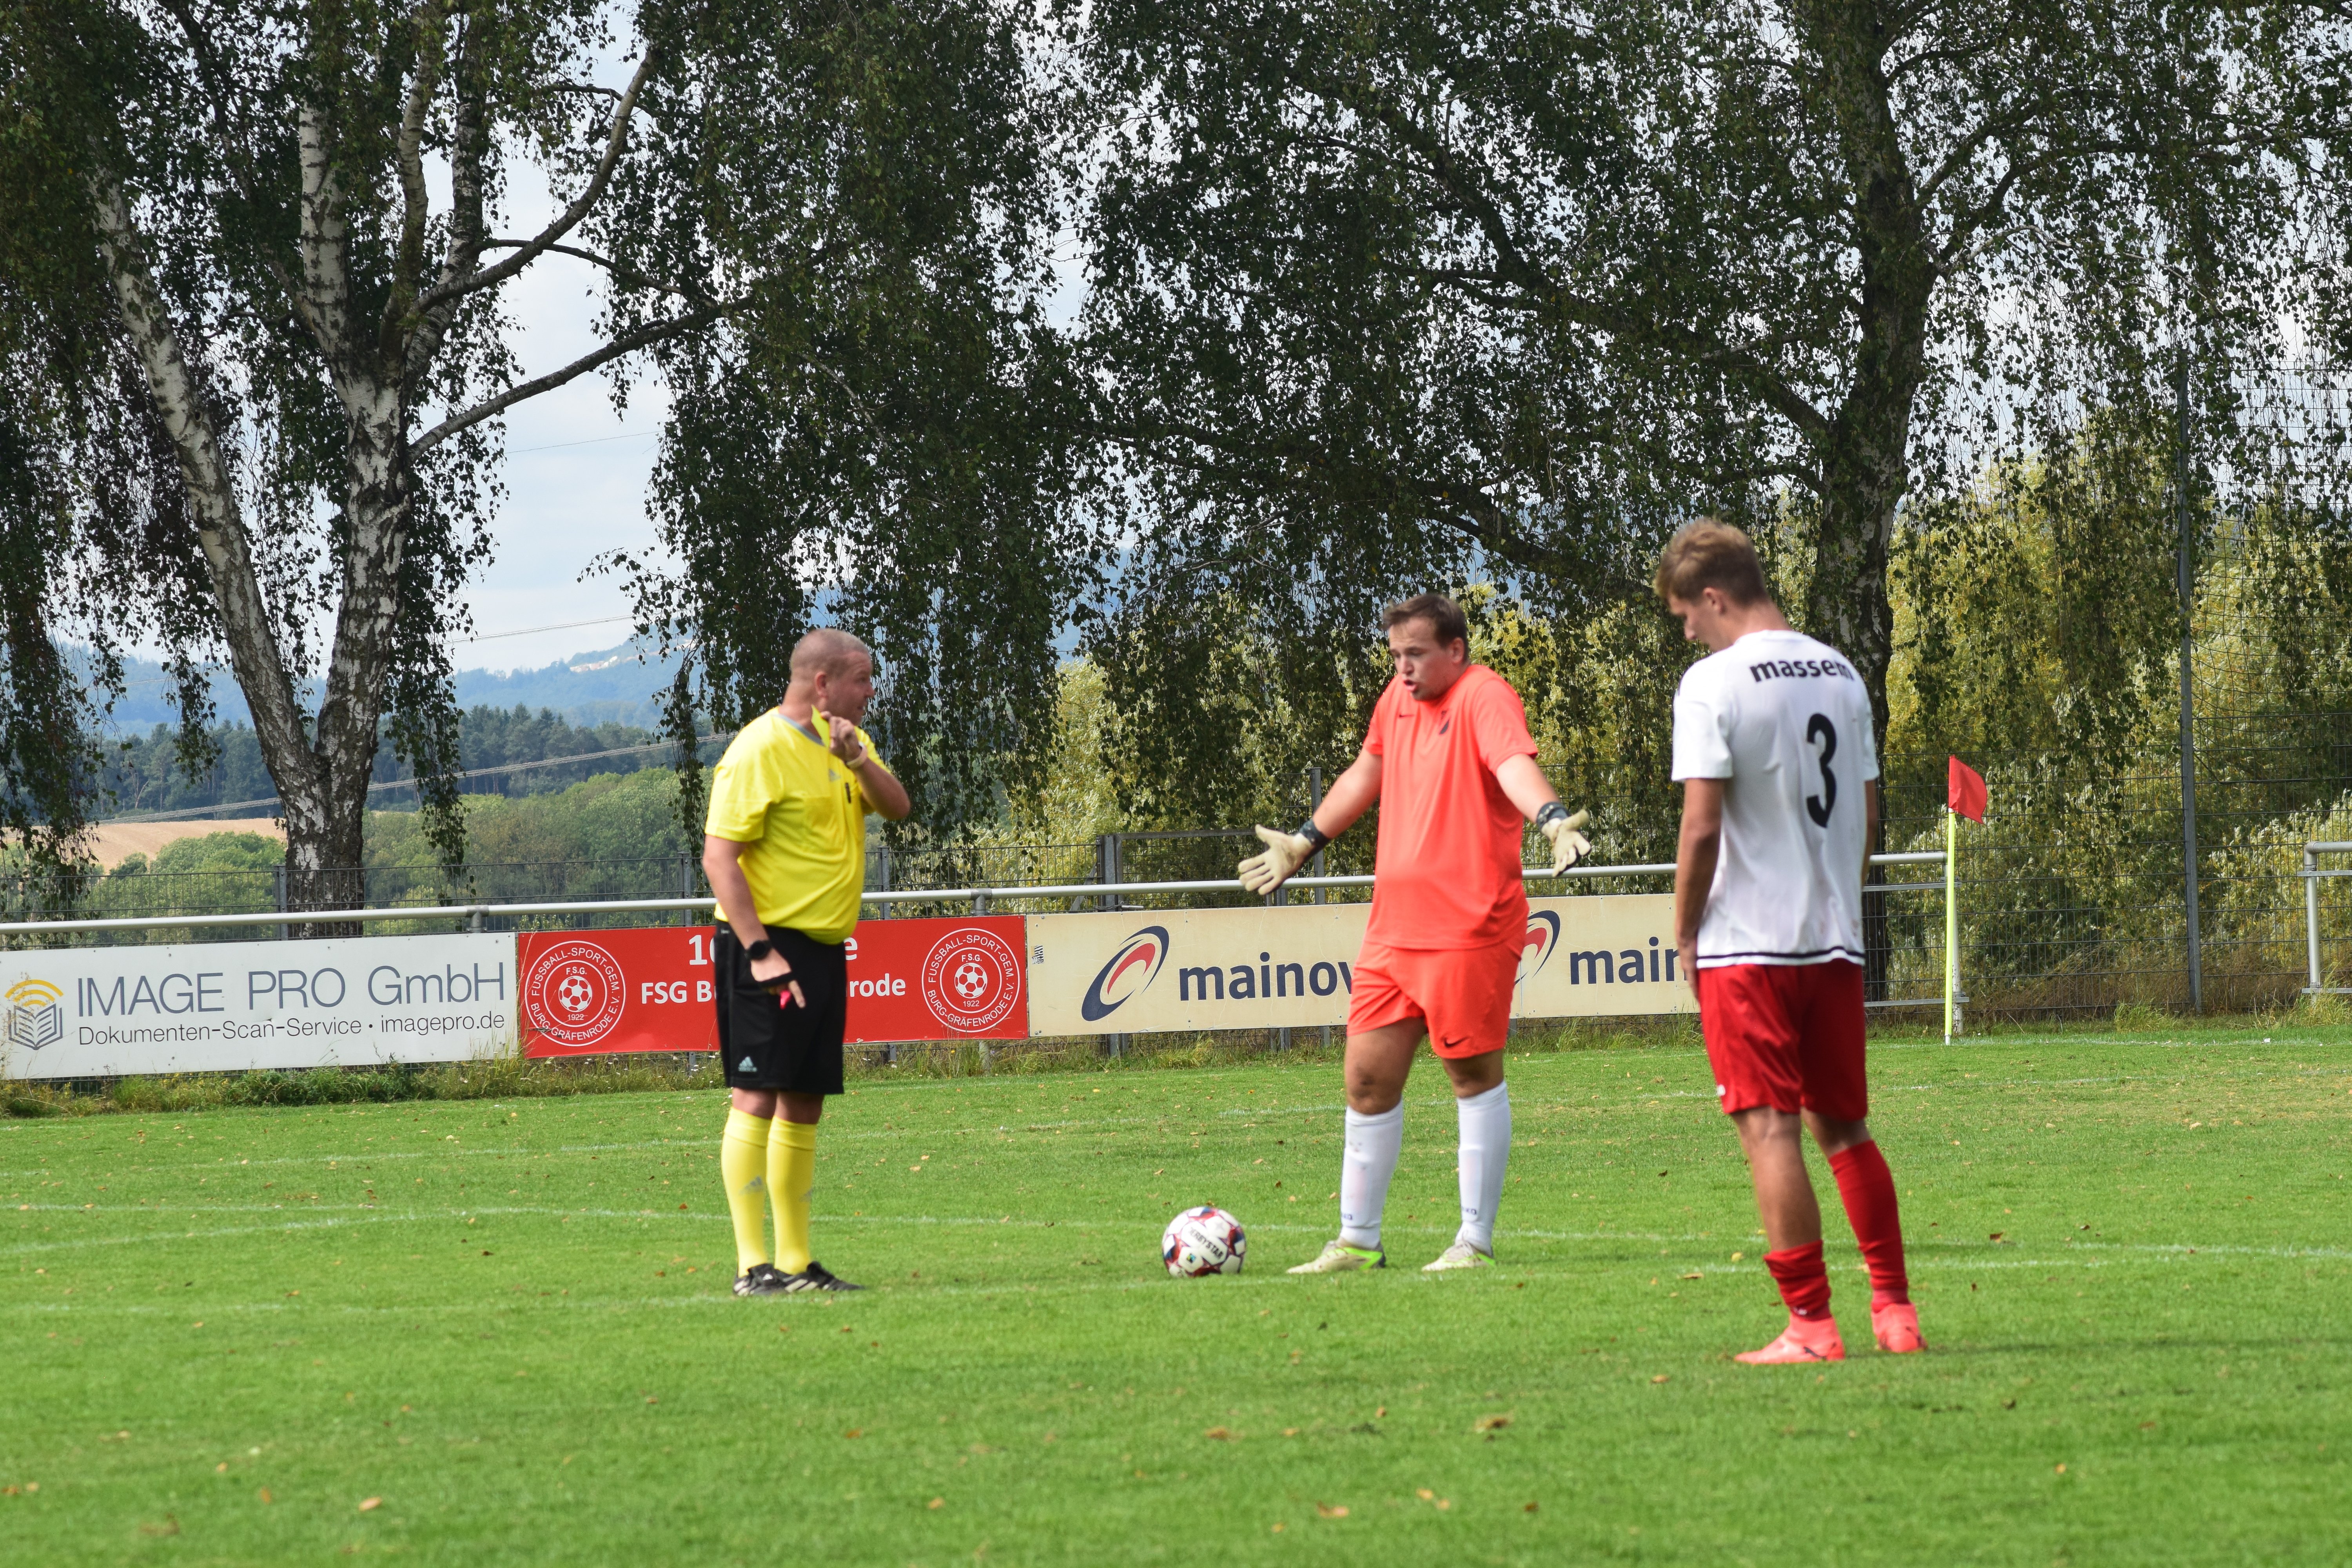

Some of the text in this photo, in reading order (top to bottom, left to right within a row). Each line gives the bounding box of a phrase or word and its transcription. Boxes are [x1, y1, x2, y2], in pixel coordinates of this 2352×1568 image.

[1806, 713, 1837, 828] 3
[532, 947, 620, 996] FUSSBALL-SPORT-GEM.
[566, 966, 587, 975] F.S.G.
[928, 935, 1014, 983] FUSSBALL-SPORT-GEM.
[962, 953, 982, 963] F.S.G.
[78, 962, 504, 1017] IMAGE PRO GmbH
[641, 981, 687, 1004] FSG
[927, 989, 1008, 1027] BURG-GRÄFENRODE
[79, 1011, 505, 1045] Dokumenten-Scan-Service imagepro.de
